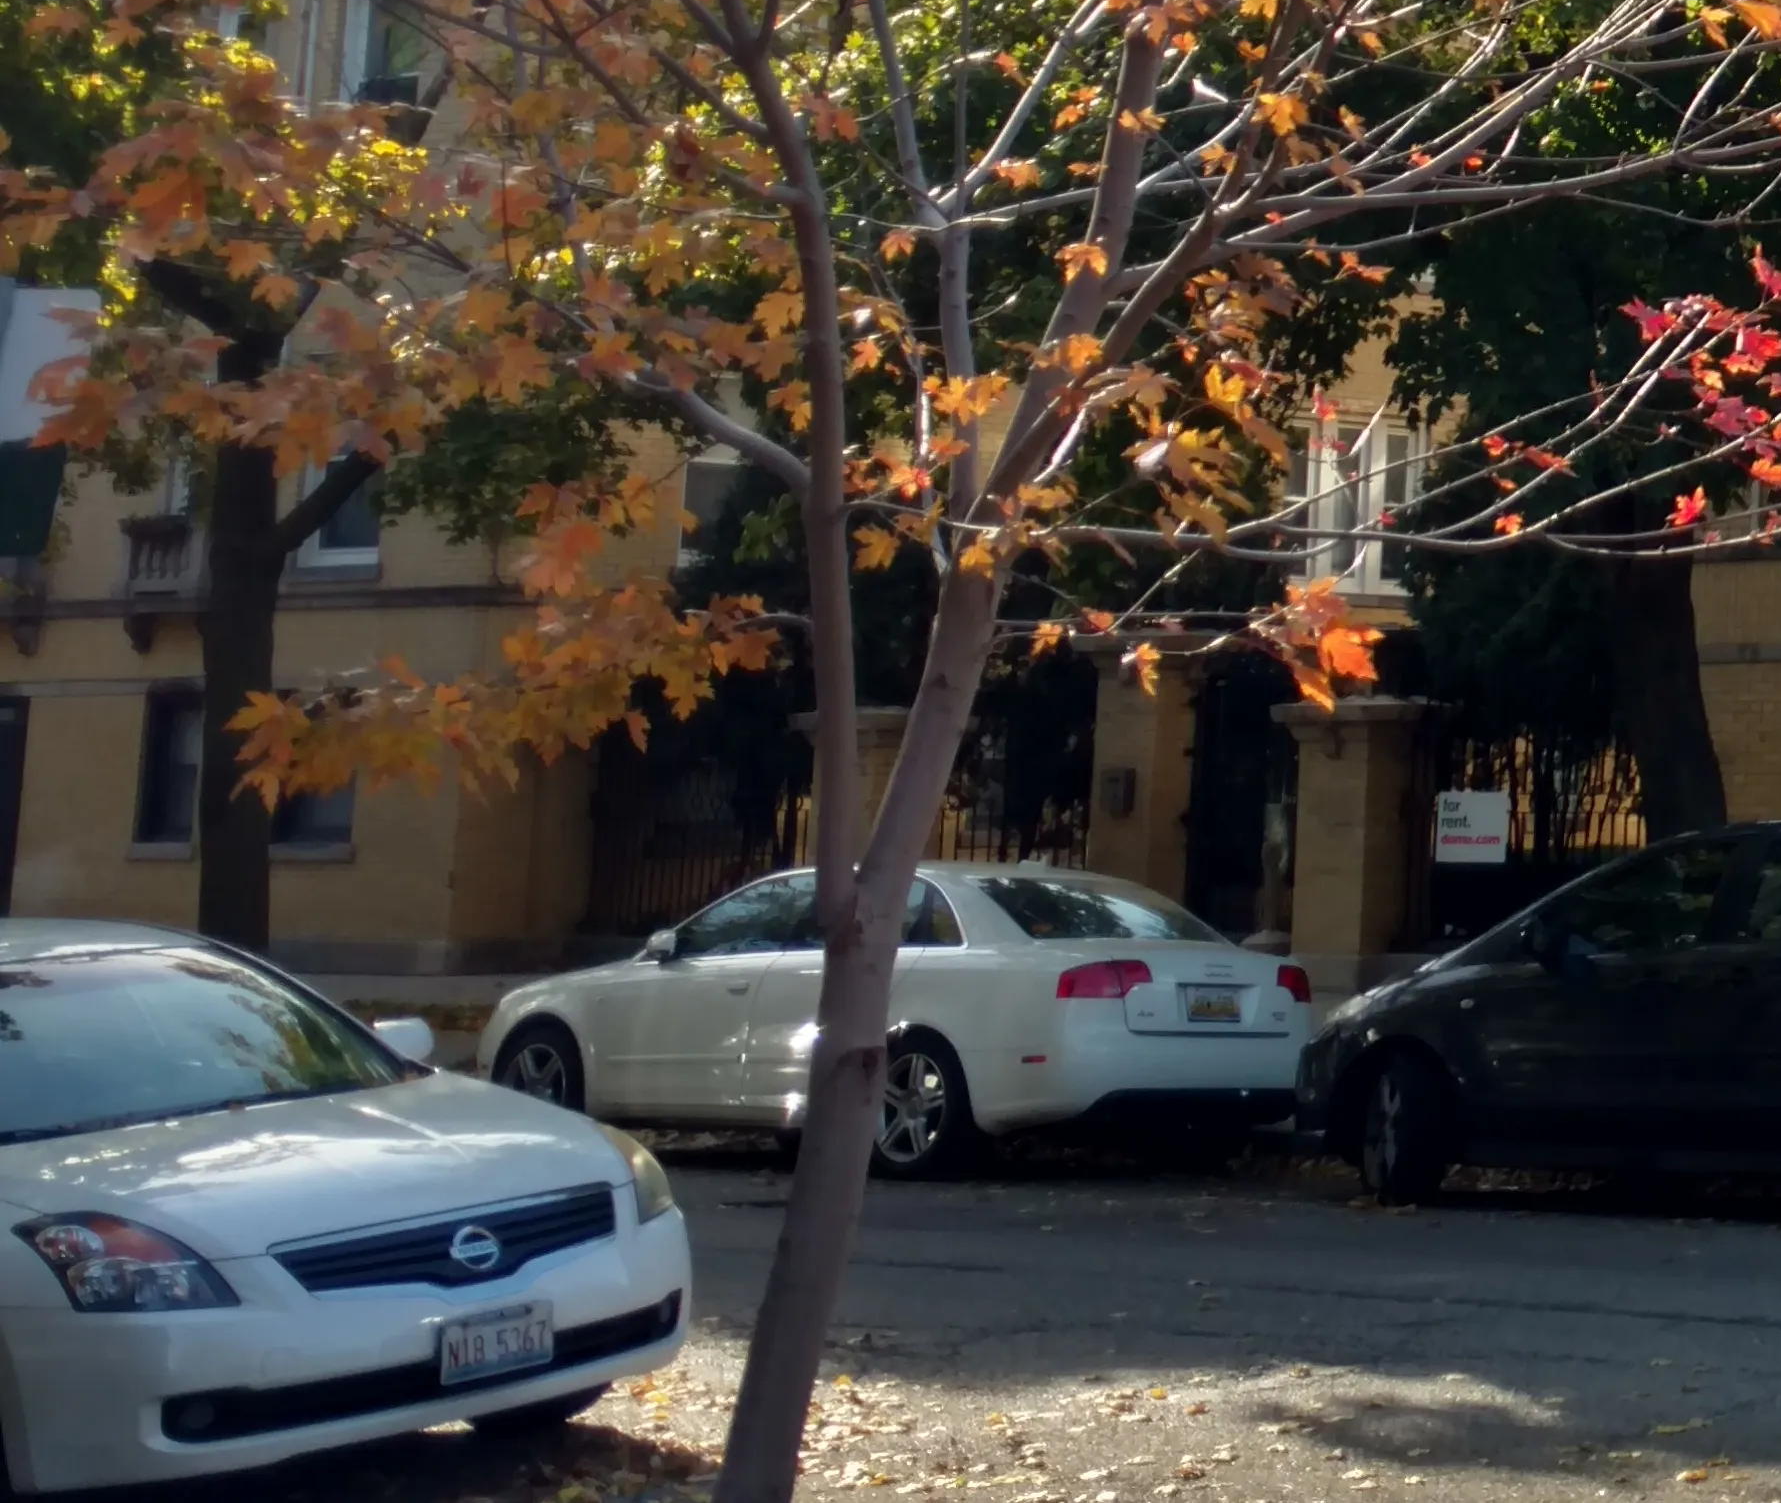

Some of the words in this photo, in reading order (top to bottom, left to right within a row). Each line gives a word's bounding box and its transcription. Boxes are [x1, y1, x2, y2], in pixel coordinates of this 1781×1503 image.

[1443, 798, 1461, 813] for
[1441, 815, 1471, 829] rent.
[495, 1320, 547, 1357] 5367
